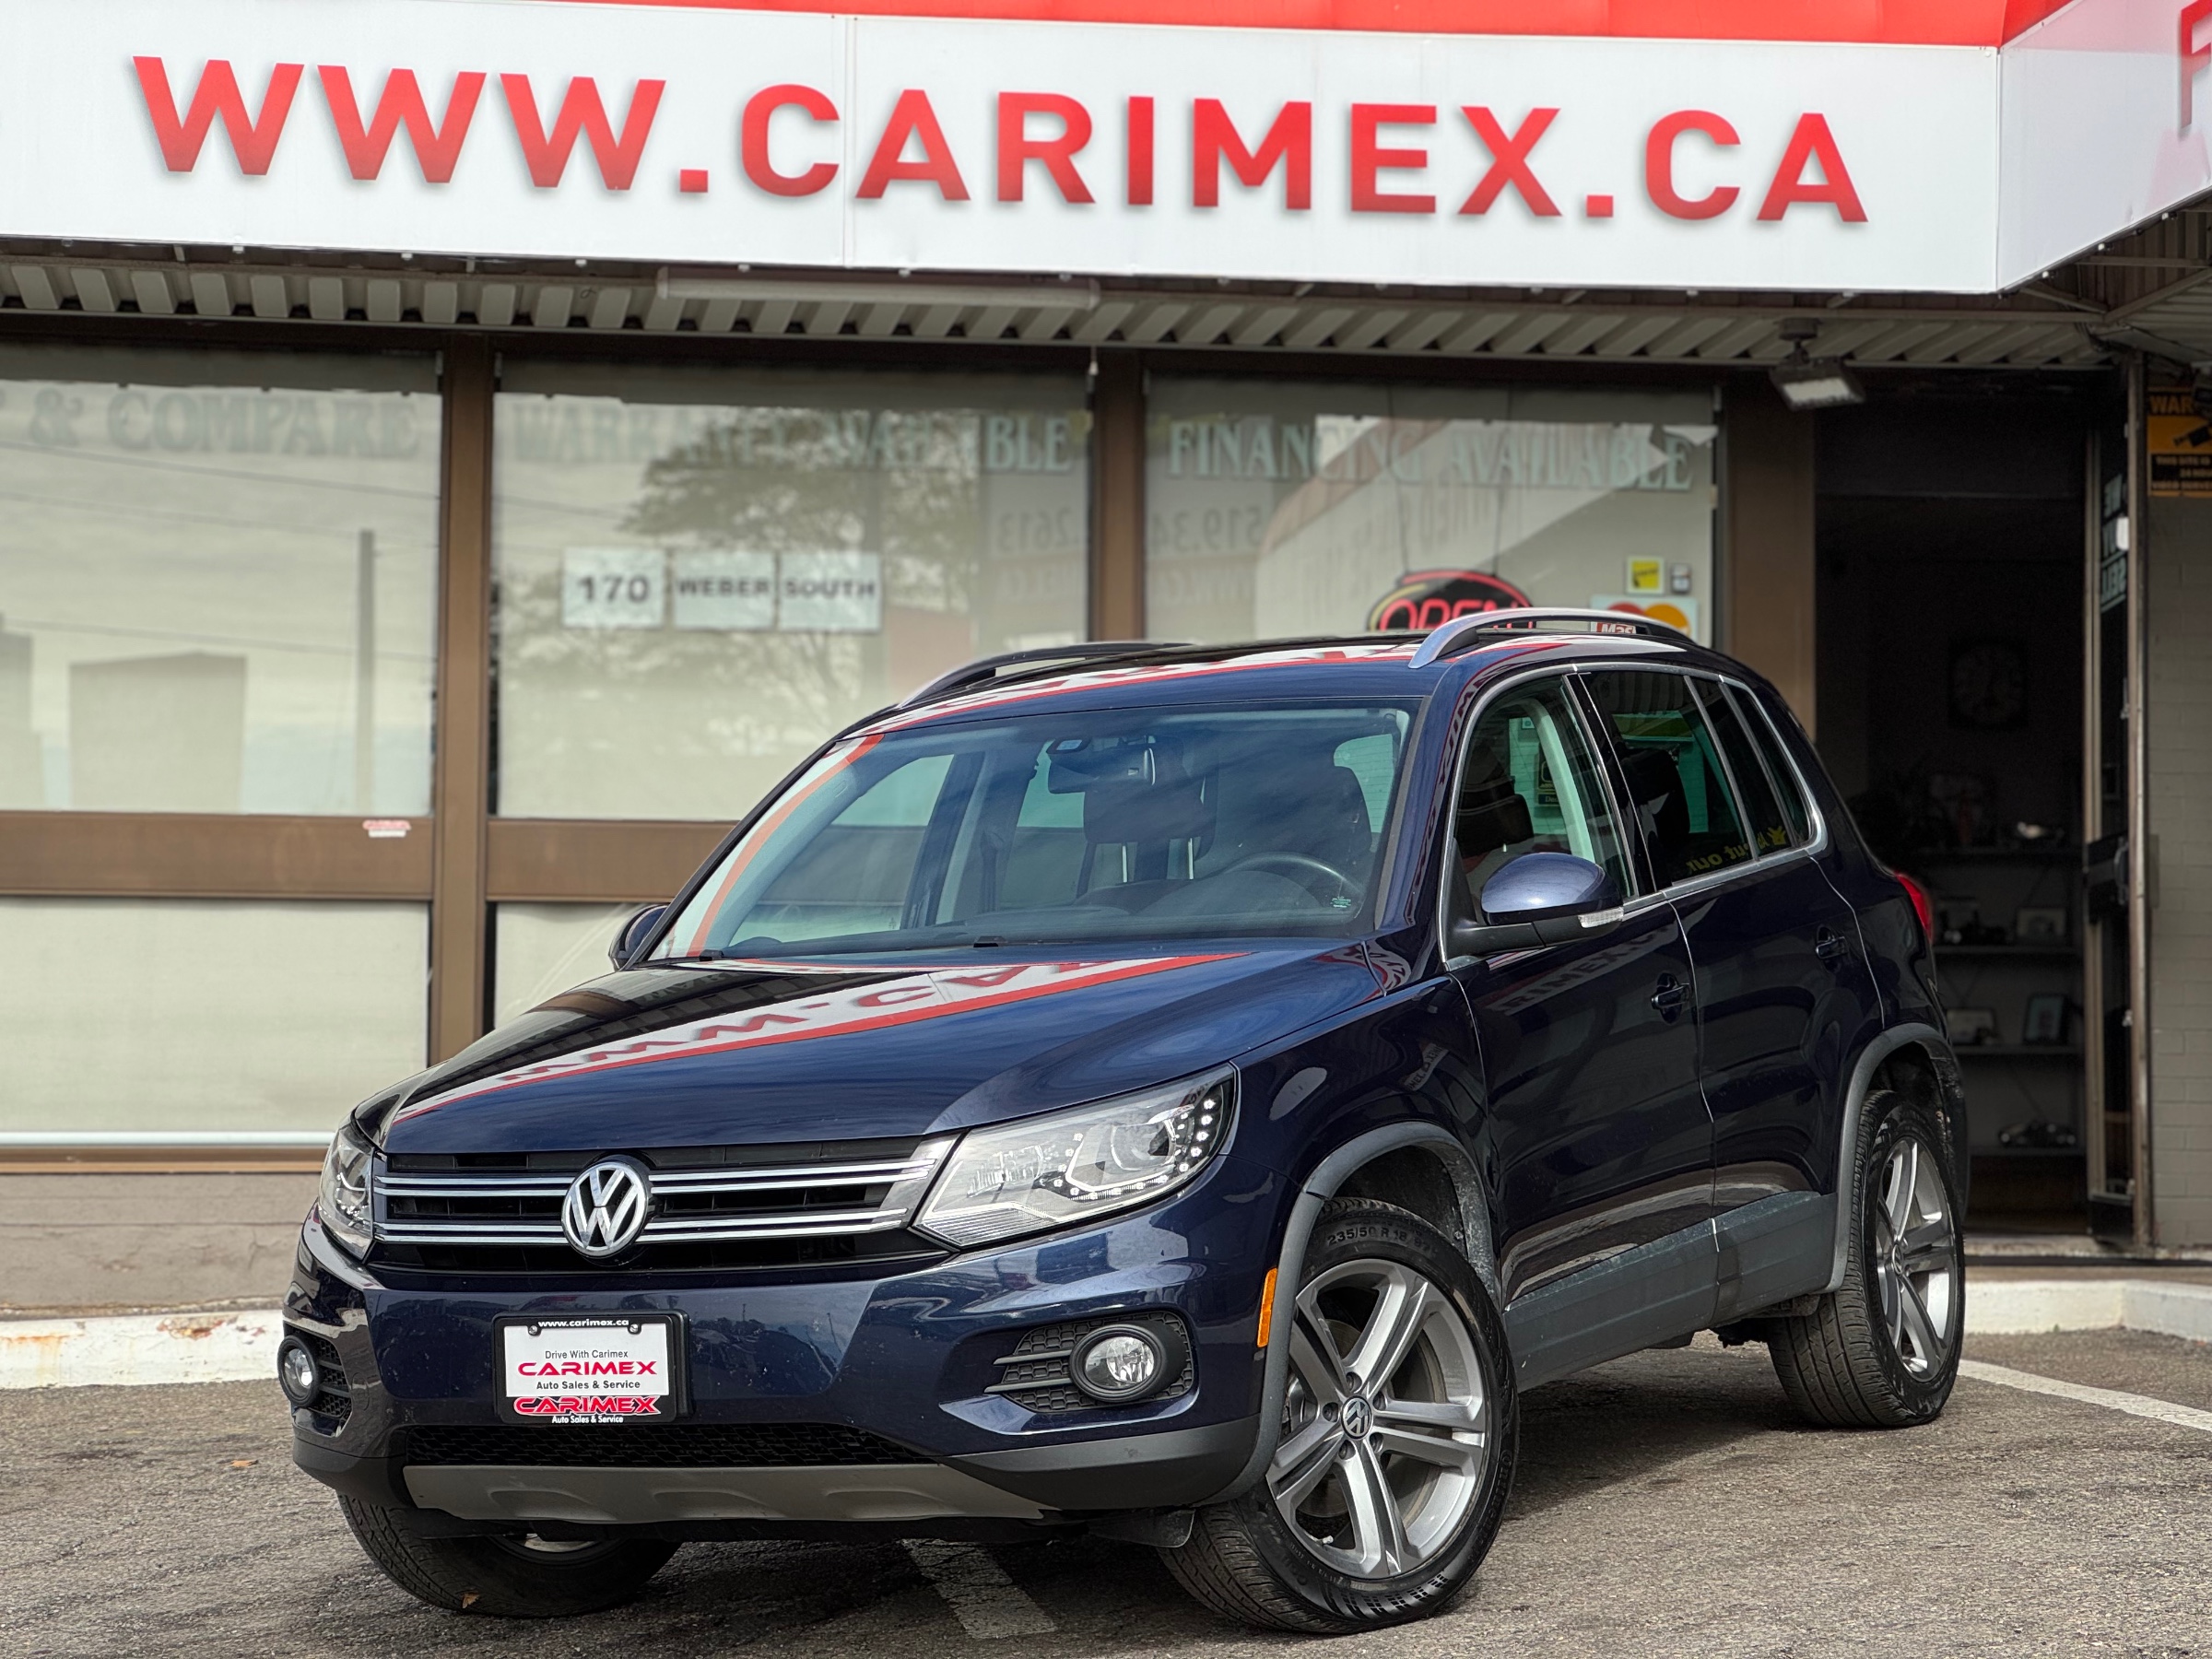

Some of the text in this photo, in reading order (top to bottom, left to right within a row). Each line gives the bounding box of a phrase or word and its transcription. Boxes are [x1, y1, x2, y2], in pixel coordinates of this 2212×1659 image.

[133, 56, 1868, 222] WWW.CARIMEX.CA
[106, 390, 420, 458] COMPARE
[1166, 420, 1695, 491] FINANCING AVAILABLE
[578, 575, 650, 605] 170
[677, 577, 877, 598] WEBER SOUTH
[1327, 1226, 1377, 1247] 235/50
[1394, 1230, 1408, 1242] 18
[538, 1319, 629, 1327] www.carimex.ca
[545, 1349, 629, 1359] Drive With Carimex
[518, 1360, 657, 1376] CARIMEX
[536, 1380, 641, 1390] Auto Sales & Service
[513, 1395, 662, 1415] CARIMEX
[552, 1415, 624, 1424] Auto Sales & Service
